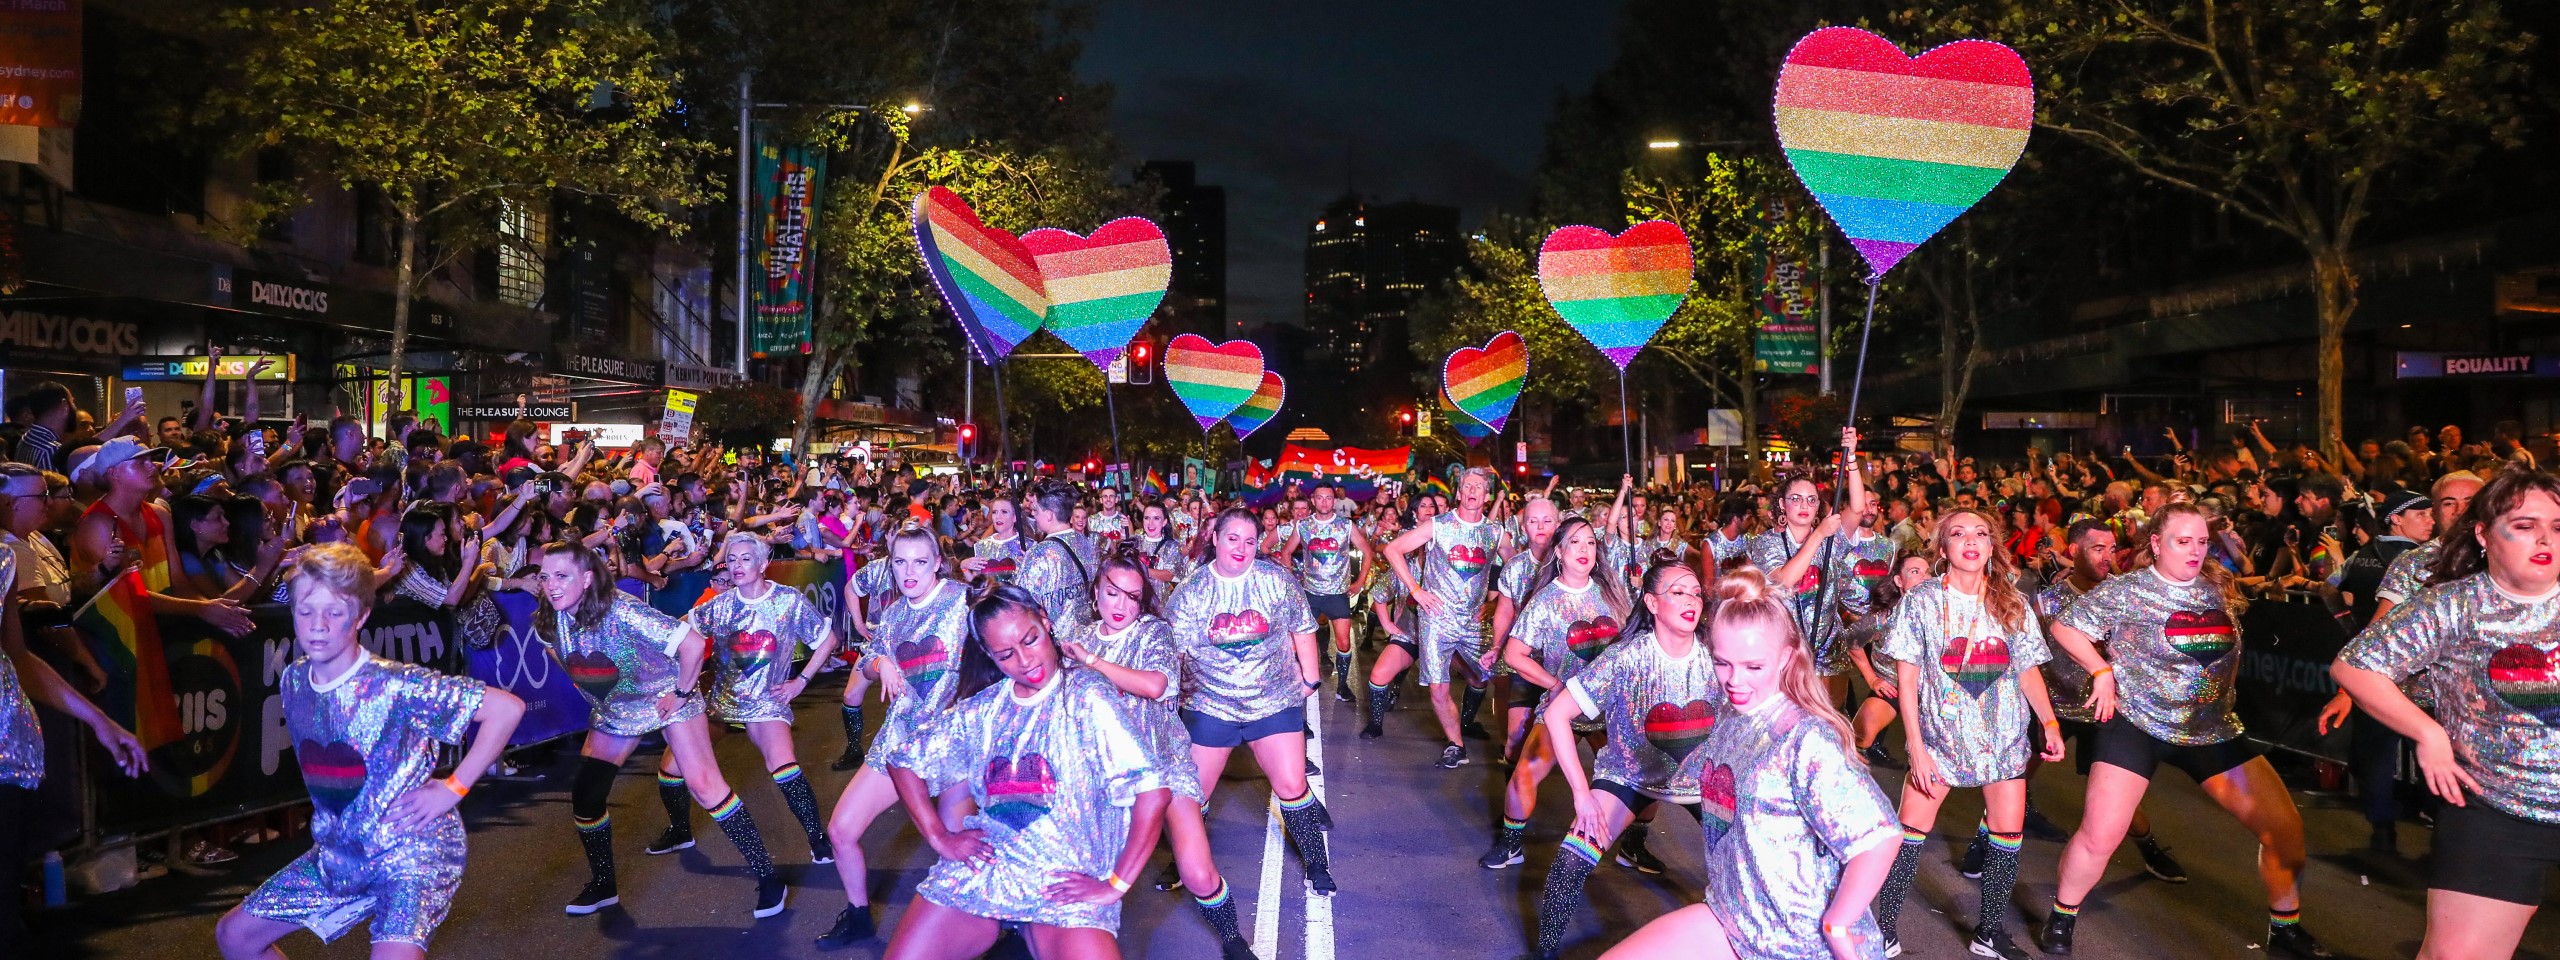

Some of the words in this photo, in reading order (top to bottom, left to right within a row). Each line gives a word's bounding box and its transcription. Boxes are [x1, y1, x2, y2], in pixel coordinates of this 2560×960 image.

[786, 171, 806, 262] MATTERS
[769, 221, 788, 279] WHAT
[251, 280, 328, 313] DAILYJOCKS
[169, 361, 245, 376] DAILYJCKS
[566, 355, 580, 372] THE
[581, 356, 625, 377] PLEASURE
[625, 361, 656, 381] LOUNGE
[2446, 356, 2531, 374] EQUALITY
[702, 370, 718, 384] PORK
[457, 407, 473, 417] THE
[529, 407, 569, 417] LOUNGE
[2353, 556, 2384, 569] POLICE
[174, 689, 227, 735] IIS
